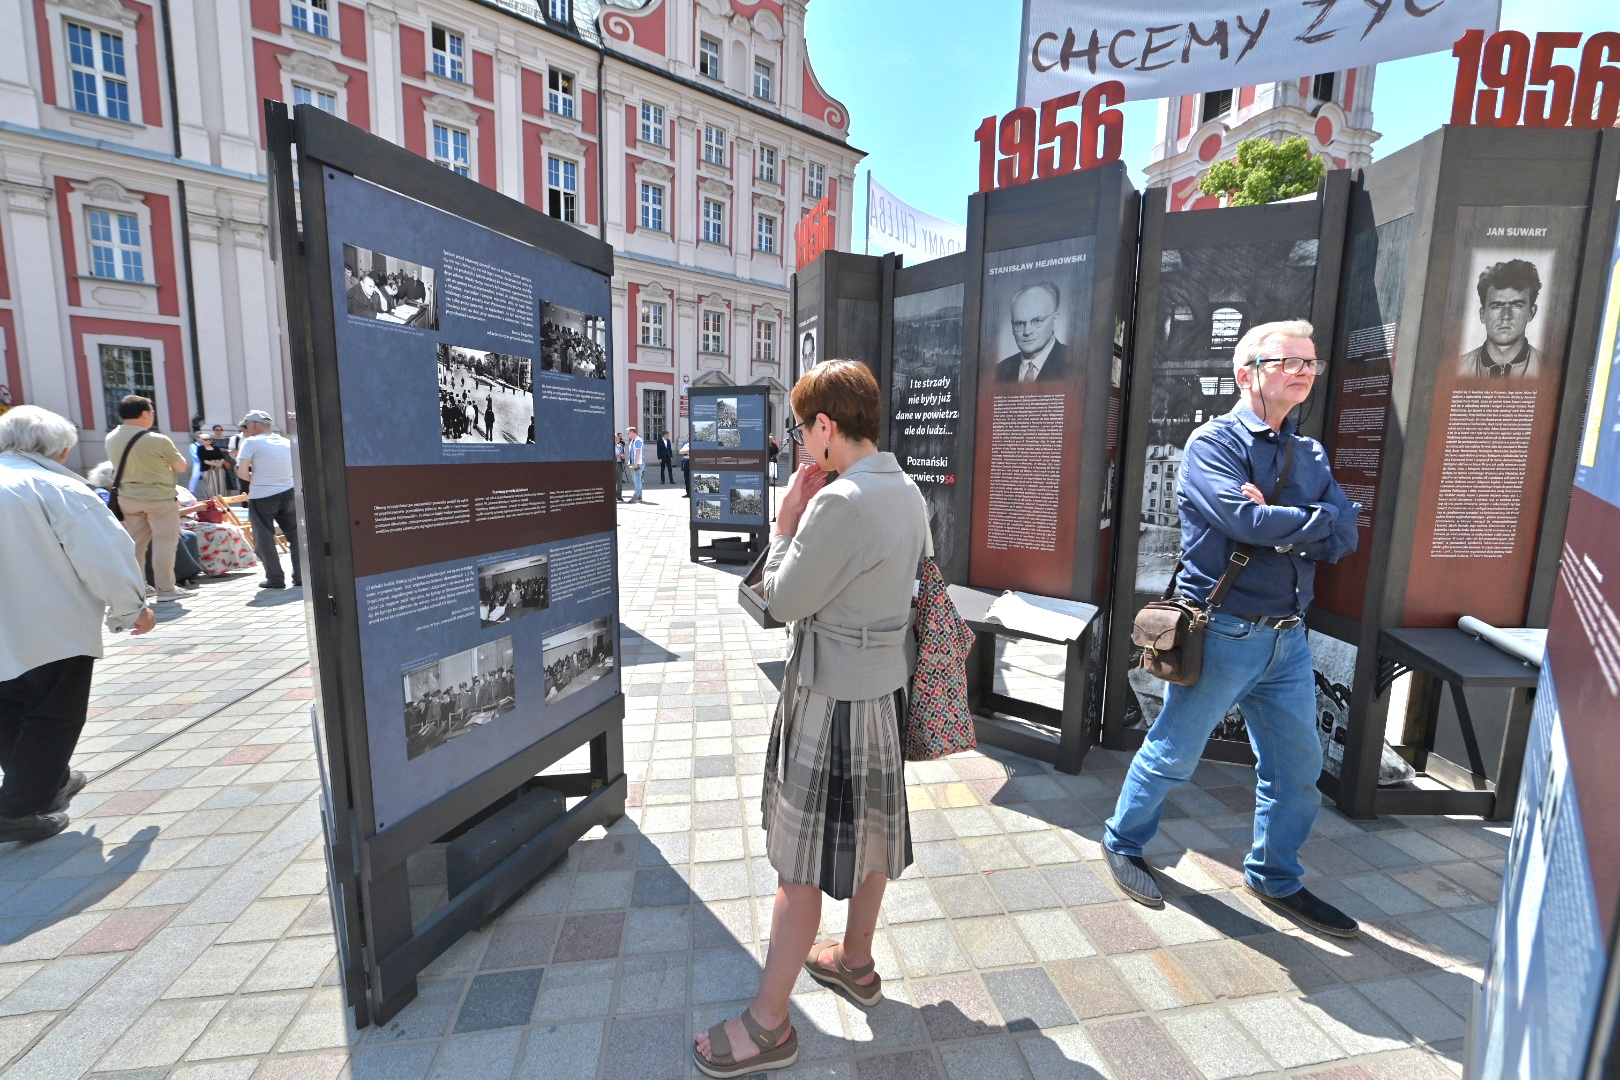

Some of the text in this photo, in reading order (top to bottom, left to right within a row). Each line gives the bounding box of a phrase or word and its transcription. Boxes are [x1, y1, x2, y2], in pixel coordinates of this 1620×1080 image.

[1032, 8, 1270, 75] CHCEMY
[1450, 29, 1620, 128] 1956
[974, 80, 1126, 192] 1956
[1486, 227, 1548, 237] JAN SUWART
[989, 253, 1087, 275] STANISŁAW HEJMOWSKI
[914, 379, 921, 388] te
[922, 375, 950, 388] strzały
[908, 391, 951, 406] nie były już
[895, 410, 913, 420] dane
[914, 411, 921, 420] w
[904, 426, 915, 435] ale
[916, 424, 925, 435] do
[907, 455, 948, 467] Poznański
[935, 474, 955, 484] 1956
